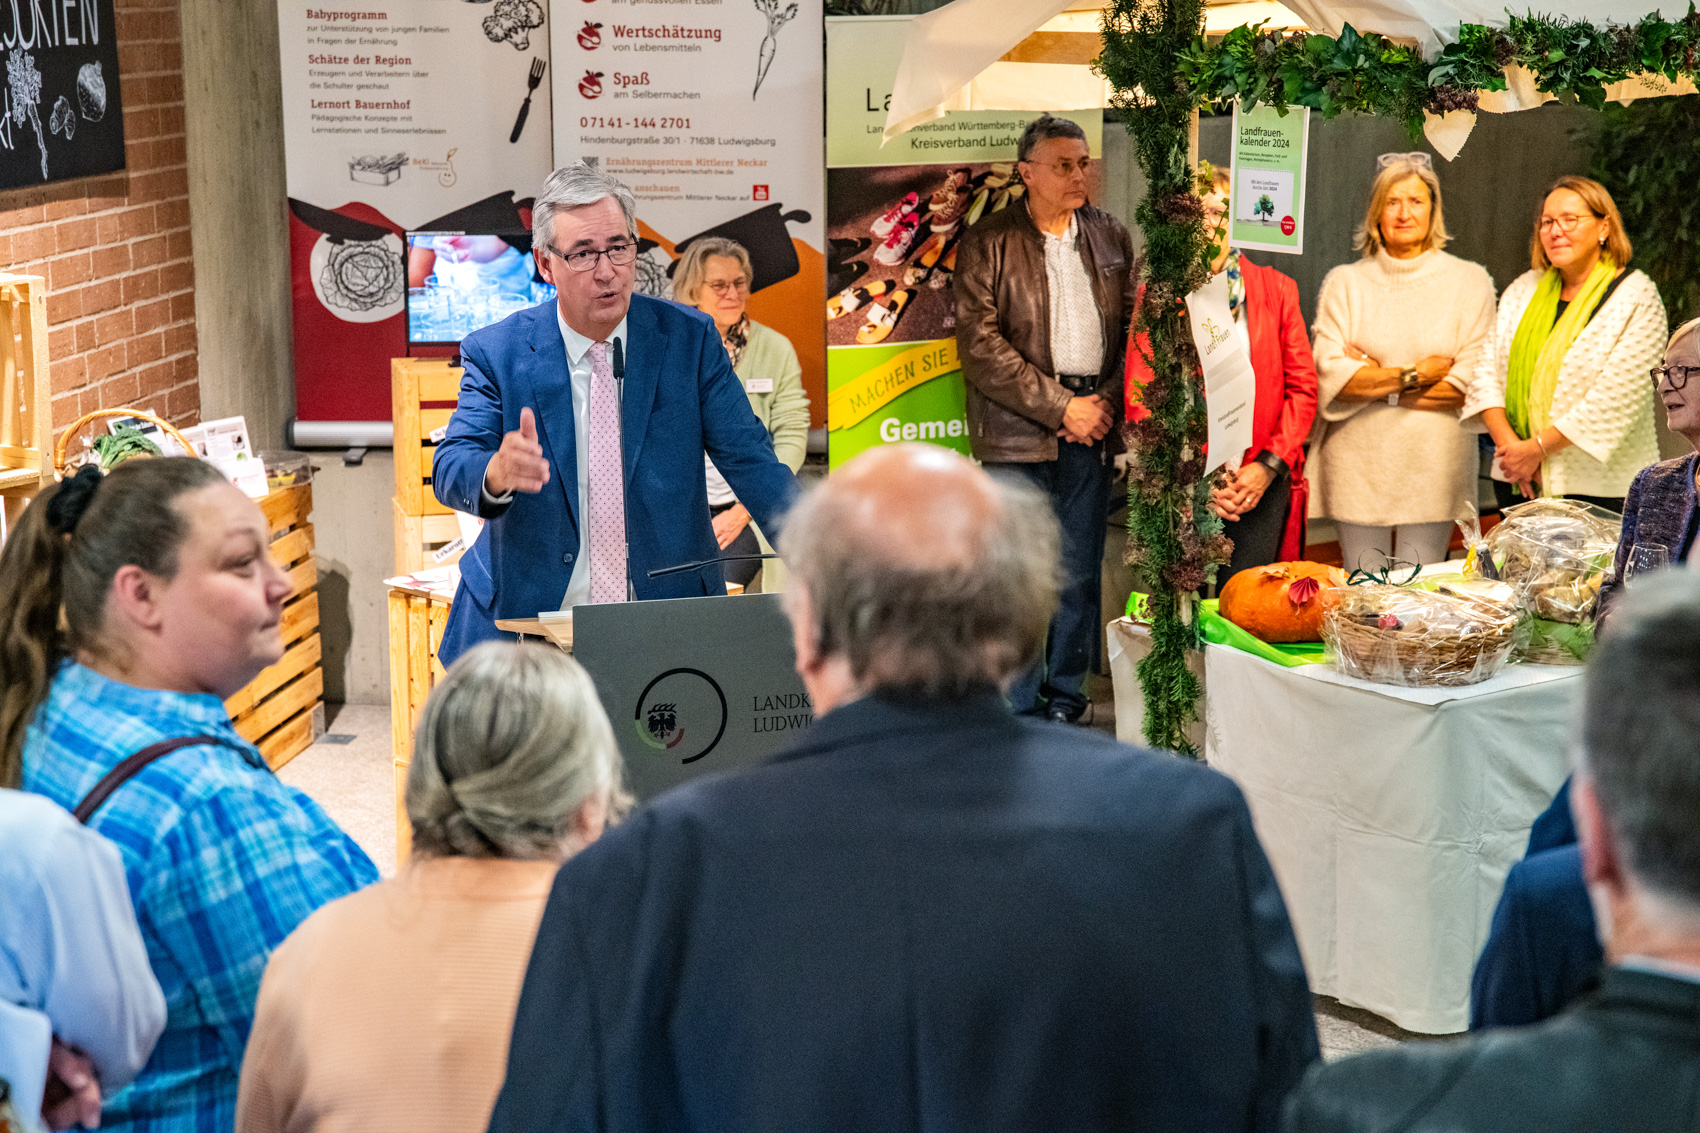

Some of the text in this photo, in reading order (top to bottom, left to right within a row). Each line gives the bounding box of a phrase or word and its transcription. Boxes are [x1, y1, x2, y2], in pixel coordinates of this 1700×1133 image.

[306, 9, 387, 22] Babyprogramm
[320, 25, 373, 34] Unterstützung
[419, 25, 449, 33] Familien
[612, 25, 721, 42] Wertschätzung
[634, 43, 701, 52] Lebensmitteln
[309, 54, 412, 67] Schätze der Region
[348, 70, 363, 78] und
[613, 72, 650, 88] Spaß
[632, 89, 700, 99] Selbermachen
[311, 99, 410, 109] Lernort Bauernhof
[661, 118, 690, 129] 2701
[1240, 126, 1284, 138] Landfrauen-
[581, 136, 660, 146] Hindenburgstraße
[690, 137, 715, 145] 71638
[718, 138, 776, 147] Ludwigsburg
[911, 136, 987, 149] Kreisverband
[1240, 135, 1290, 148] kalender 2024
[606, 157, 692, 168] Ernährungszentrum
[849, 348, 949, 412] MACHEN SIE
[753, 693, 812, 711] LANDK
